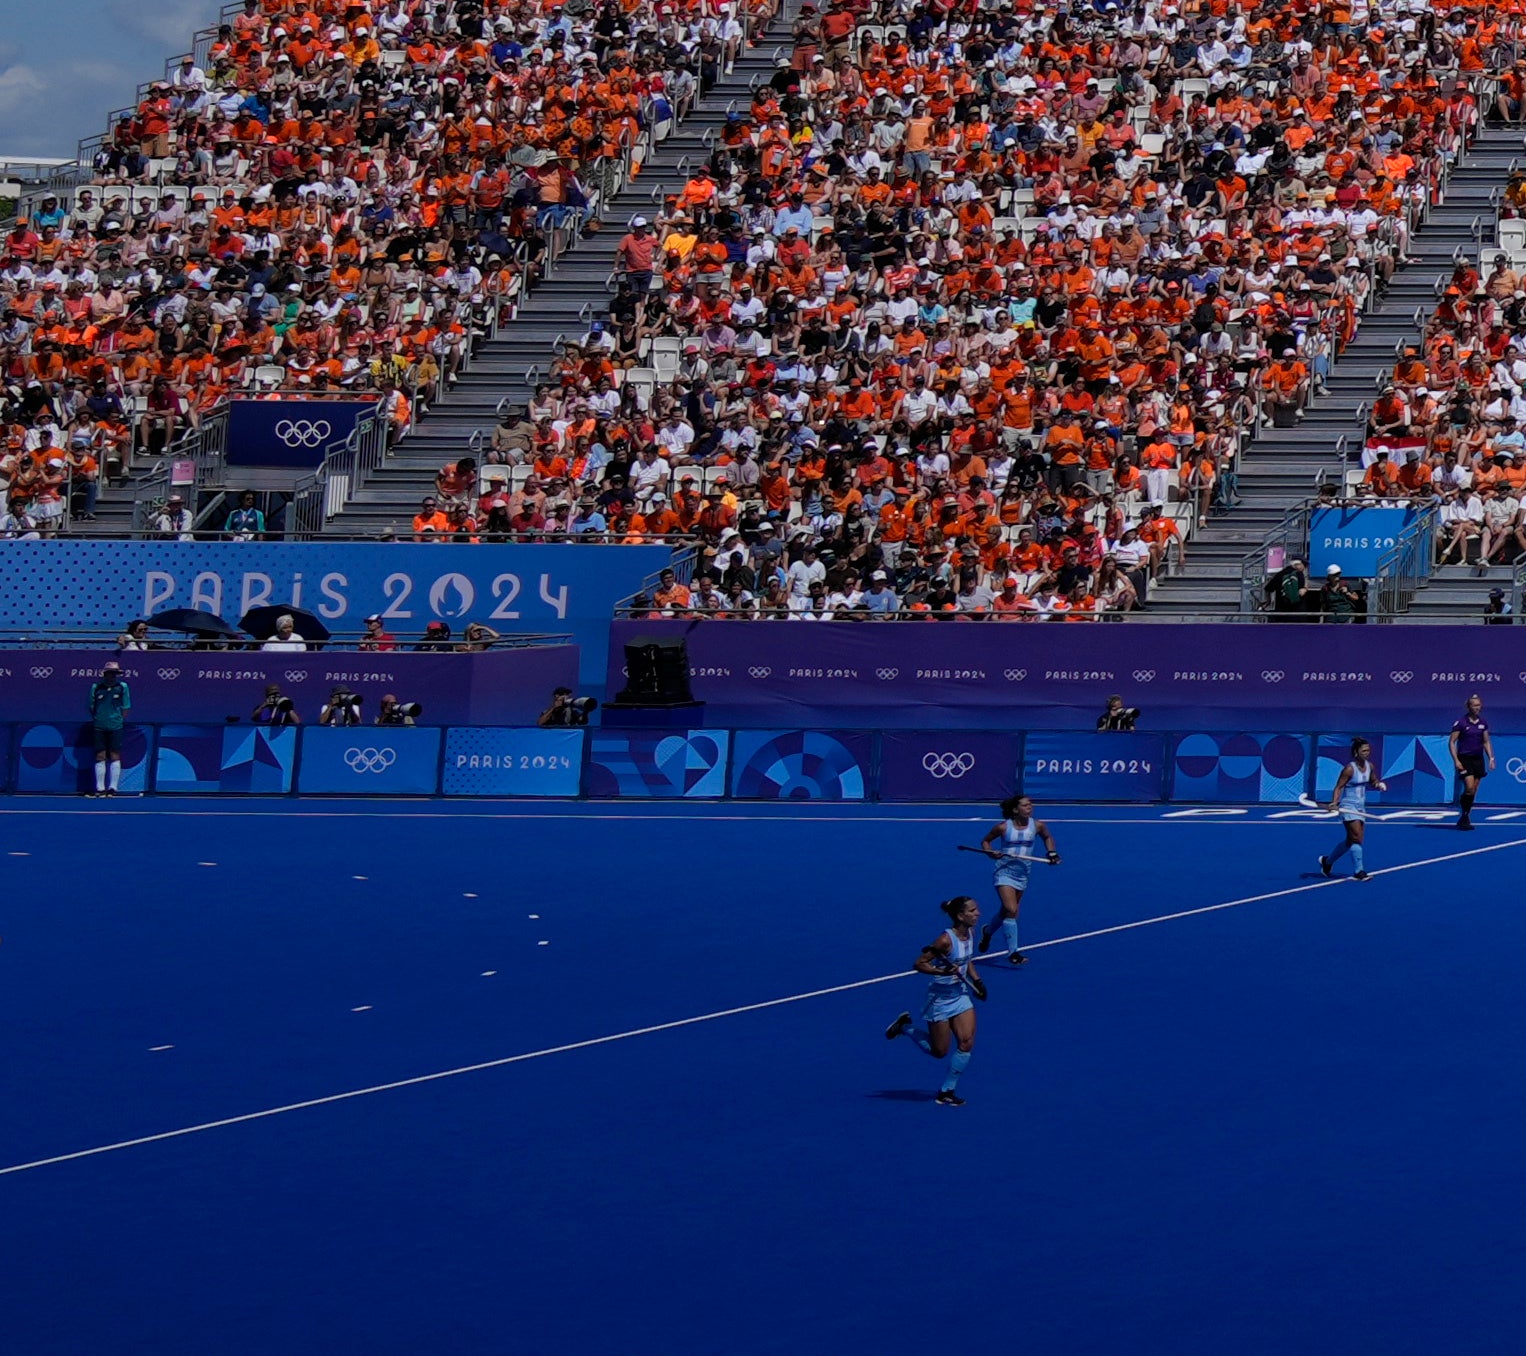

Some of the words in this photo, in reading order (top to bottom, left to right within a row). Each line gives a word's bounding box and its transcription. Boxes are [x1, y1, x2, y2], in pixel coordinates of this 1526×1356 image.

[1325, 538, 1369, 549] PARIS
[143, 571, 348, 619] PARIS
[382, 572, 568, 619] 2024
[198, 671, 232, 679] PARIS
[236, 671, 265, 679] 2024
[790, 669, 823, 677] PARIS
[827, 669, 857, 677] 2024
[917, 670, 950, 678] PARIS
[955, 670, 985, 678] 2024
[1045, 671, 1079, 679] PARIS
[1083, 672, 1113, 680] 2024
[1174, 672, 1207, 680] PARIS
[1212, 672, 1242, 680] 2024
[1303, 672, 1336, 681] PARIS
[1340, 673, 1371, 681] 2024
[1432, 673, 1465, 681] PARIS
[1469, 673, 1500, 681] 2024
[457, 755, 512, 768] PARIS
[521, 756, 569, 769] 2024
[1037, 760, 1092, 773] PARIS
[1100, 760, 1150, 773] 2024
